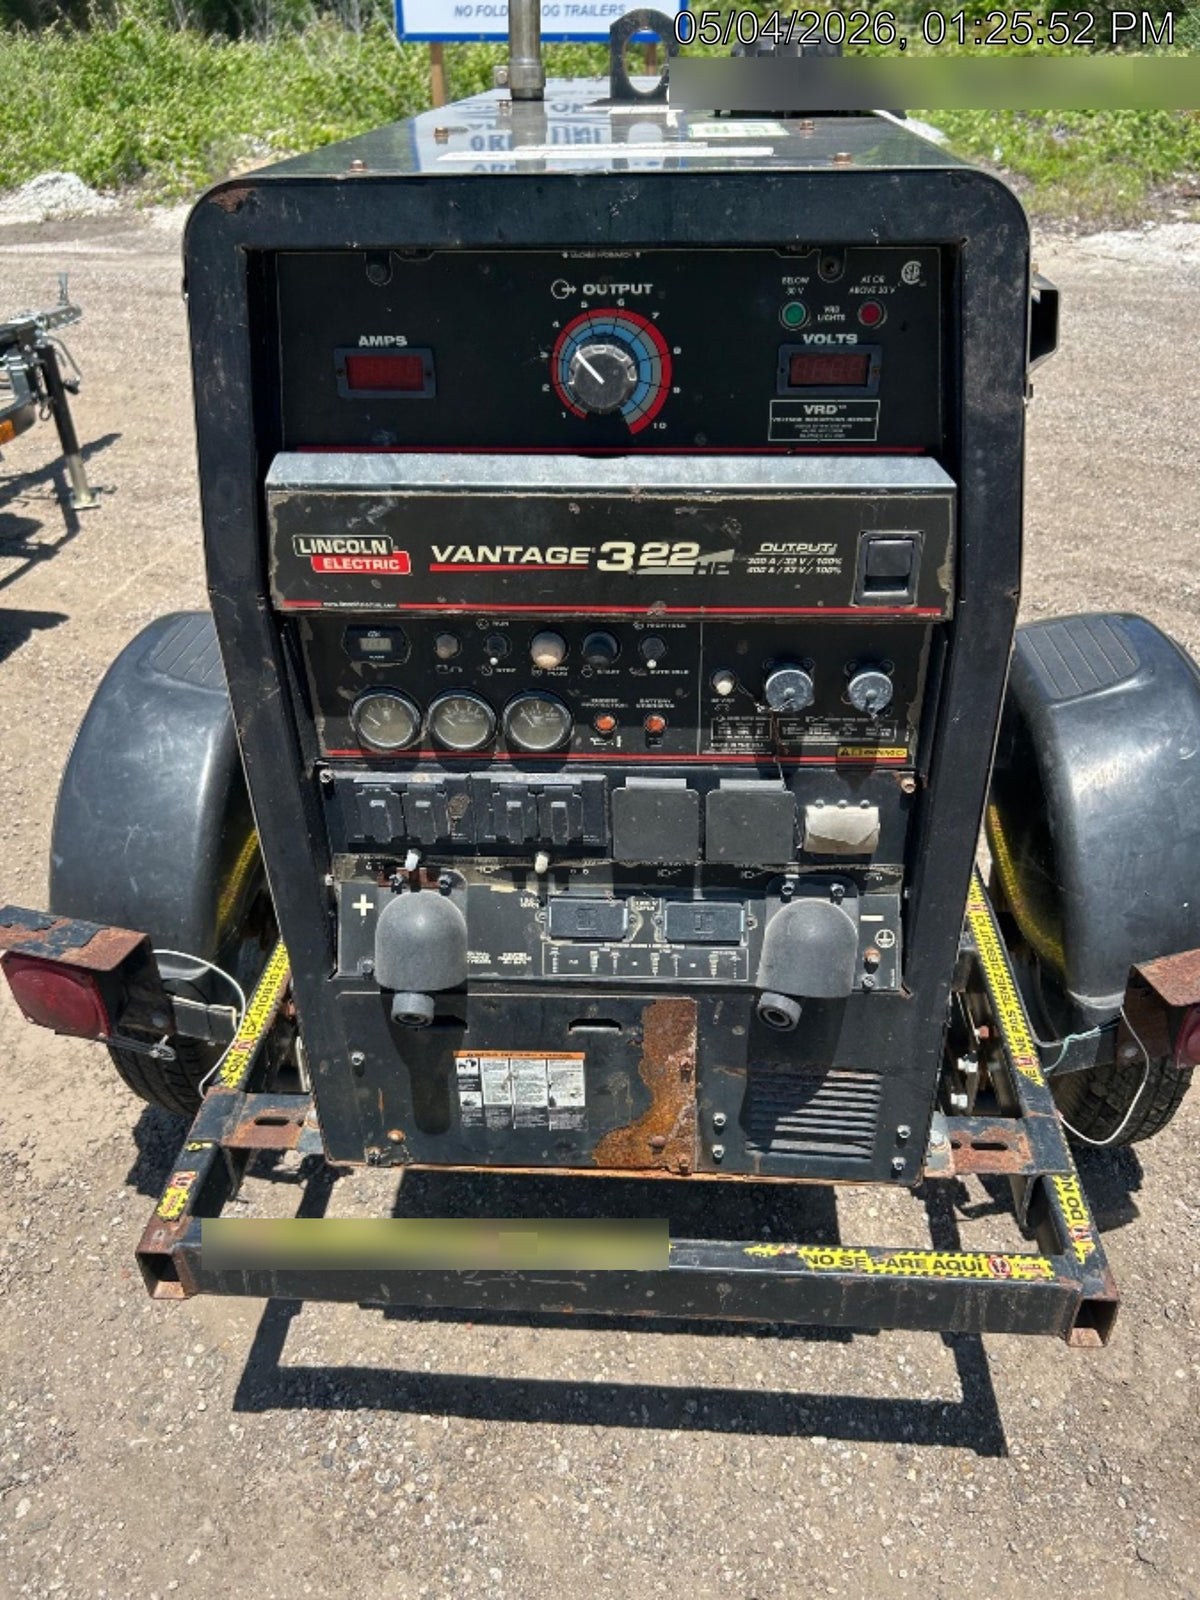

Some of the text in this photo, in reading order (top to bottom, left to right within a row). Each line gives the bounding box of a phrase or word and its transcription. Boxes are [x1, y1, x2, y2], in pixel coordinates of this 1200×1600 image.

[454, 5, 471, 17] NO
[476, 5, 509, 17] FOLD
[555, 4, 626, 17] TRAILERS
[582, 283, 653, 295] OUTPUT
[358, 335, 408, 347] AMPS
[803, 333, 858, 344] VOLTS
[298, 538, 389, 555] LINCOLN
[760, 543, 834, 552] OUTPUT
[431, 541, 701, 572] VANTAGE 322
[322, 557, 401, 570] ELECTRIC
[993, 972, 1012, 1009] TENEZ
[1006, 1010, 1019, 1034] PAS
[1015, 1035, 1028, 1051] NE
[1066, 1195, 1084, 1221] DO
[804, 1254, 835, 1266] NO
[840, 1254, 867, 1267] SE
